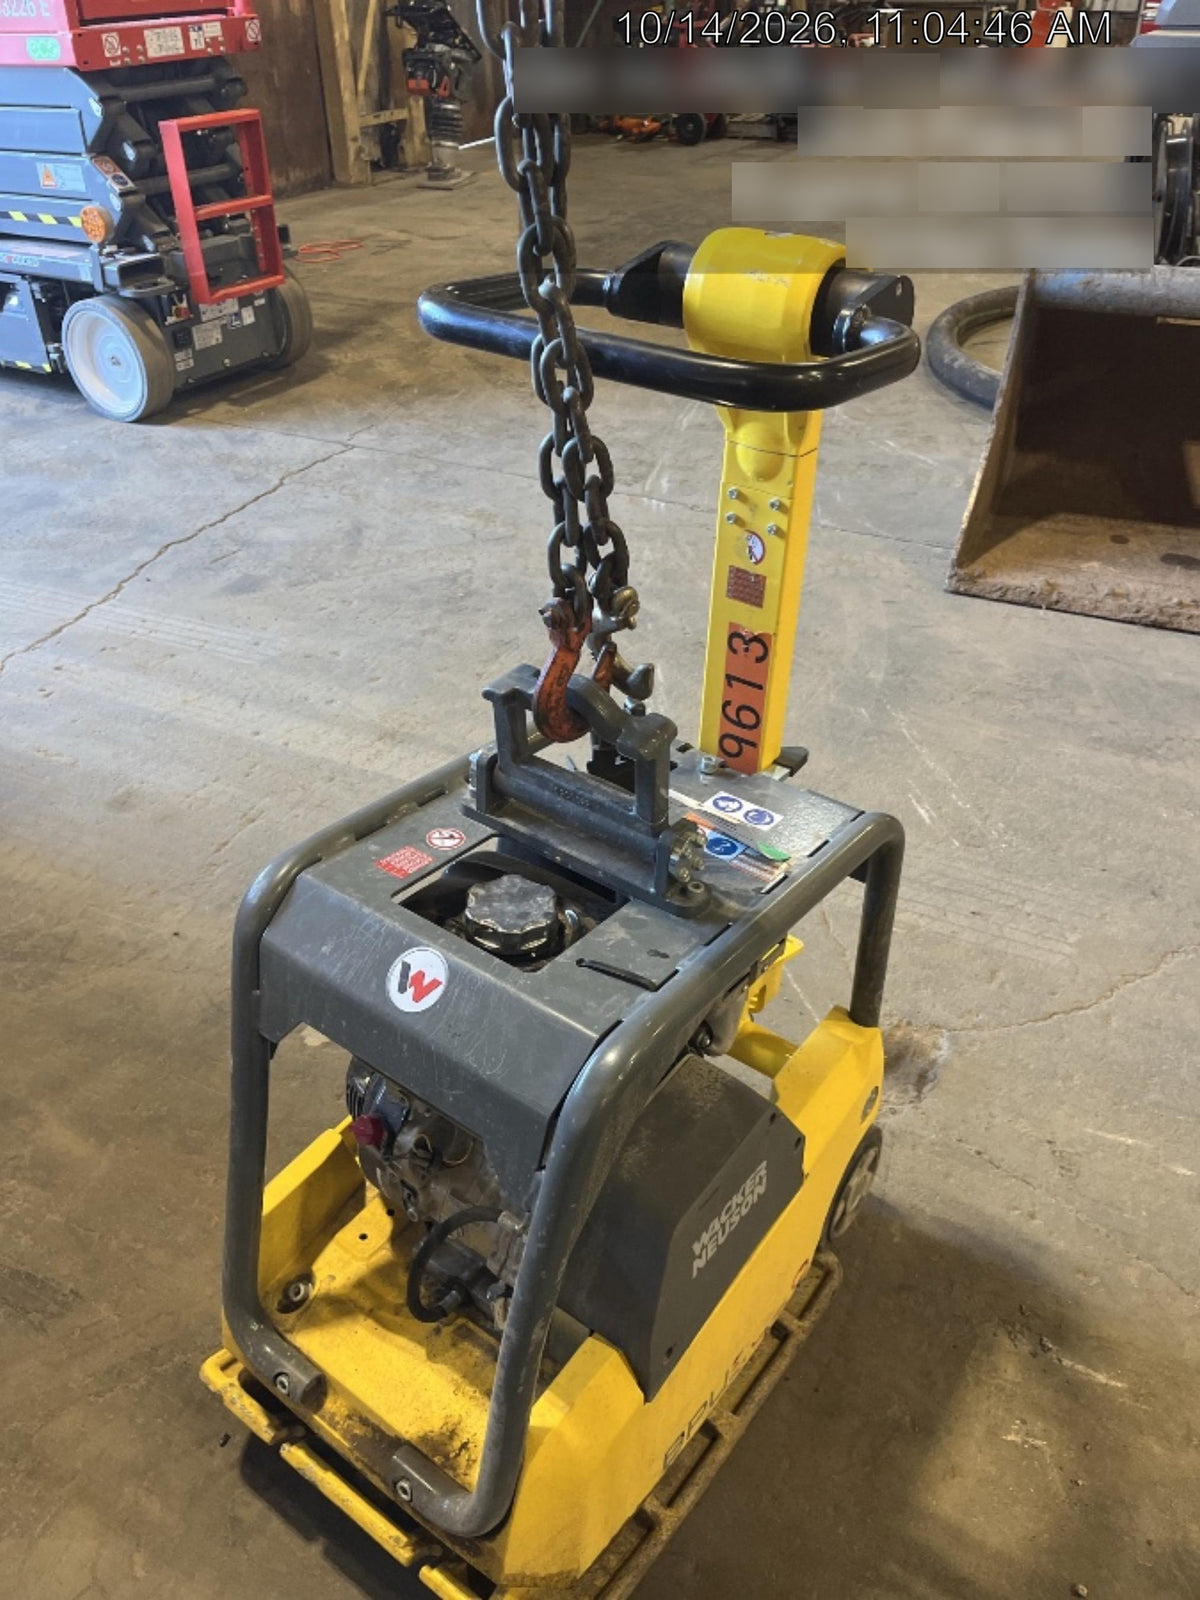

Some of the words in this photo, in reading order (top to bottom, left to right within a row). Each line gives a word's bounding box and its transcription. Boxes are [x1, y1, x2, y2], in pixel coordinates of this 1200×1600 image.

[718, 630, 769, 758] 9613
[691, 1160, 768, 1256] WACKER
[691, 1172, 768, 1279] NEUSON
